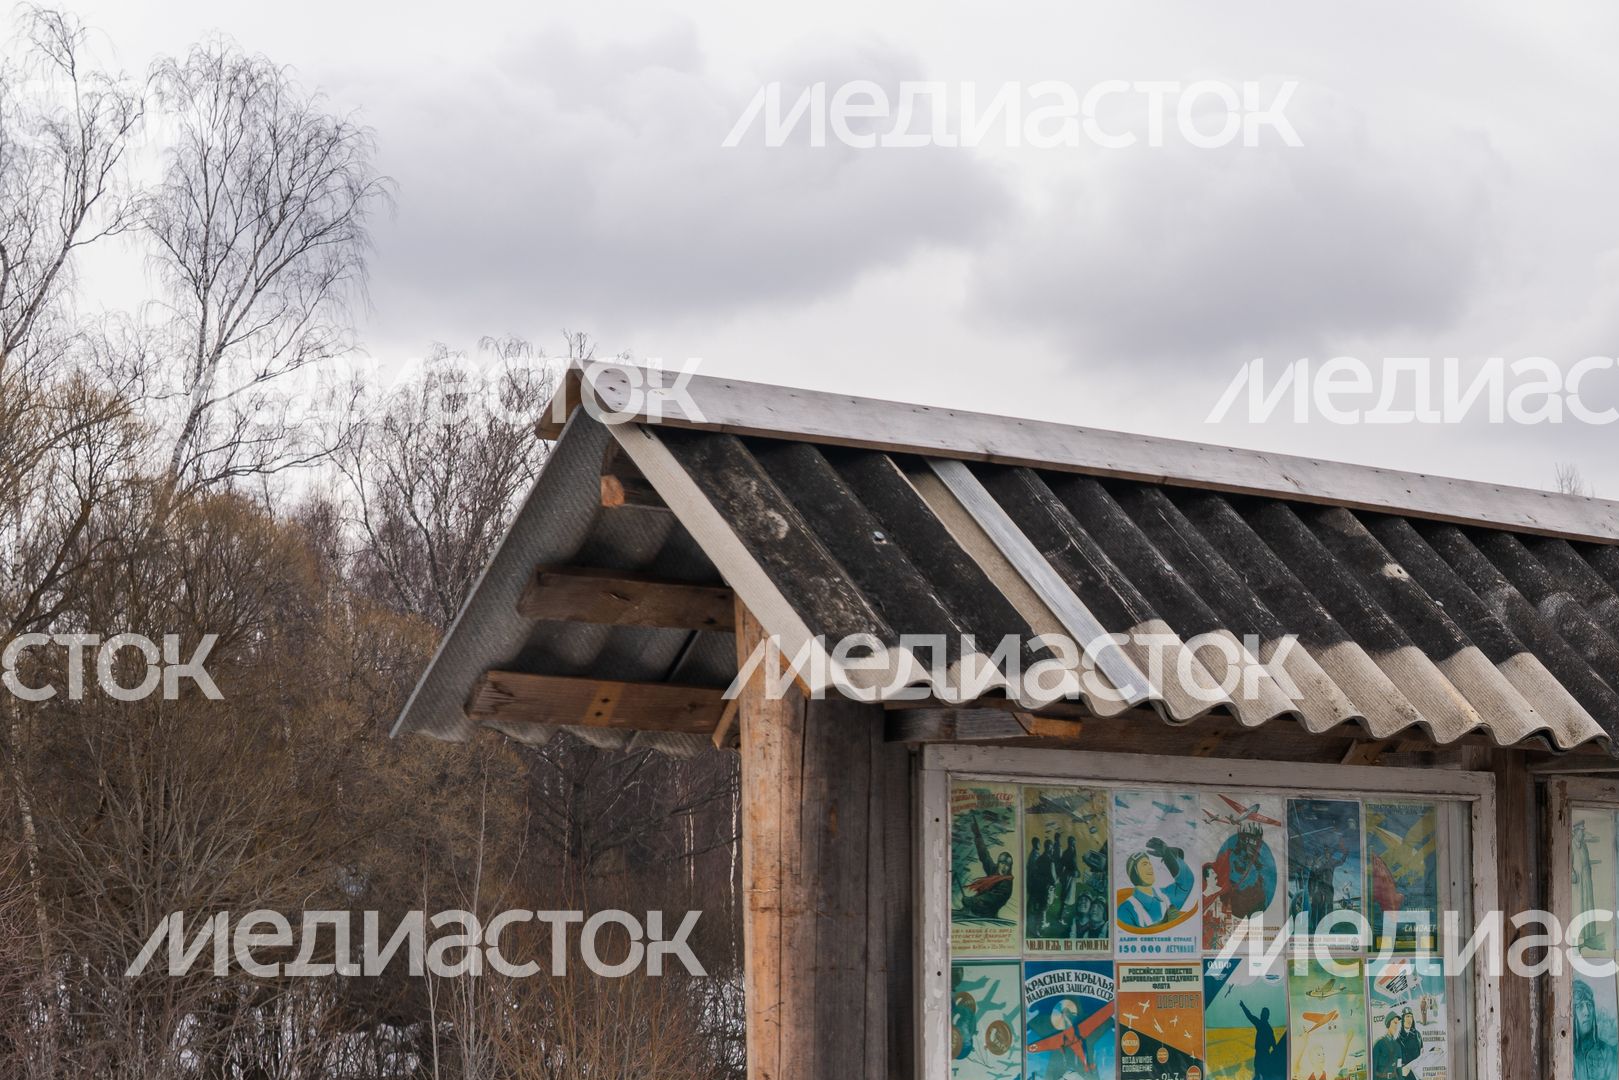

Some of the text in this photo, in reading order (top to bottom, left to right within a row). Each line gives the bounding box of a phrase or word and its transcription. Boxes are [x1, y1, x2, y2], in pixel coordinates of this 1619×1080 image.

[1119, 944, 1162, 954] 150.000
[1025, 971, 1115, 995] КРАСНЫЕ КРЫЛЬЯ
[1066, 983, 1095, 996] ЗАЩИТА
[1096, 987, 1114, 1001] СССР
[1121, 1056, 1153, 1064] ВОЗДУШНОЕ
